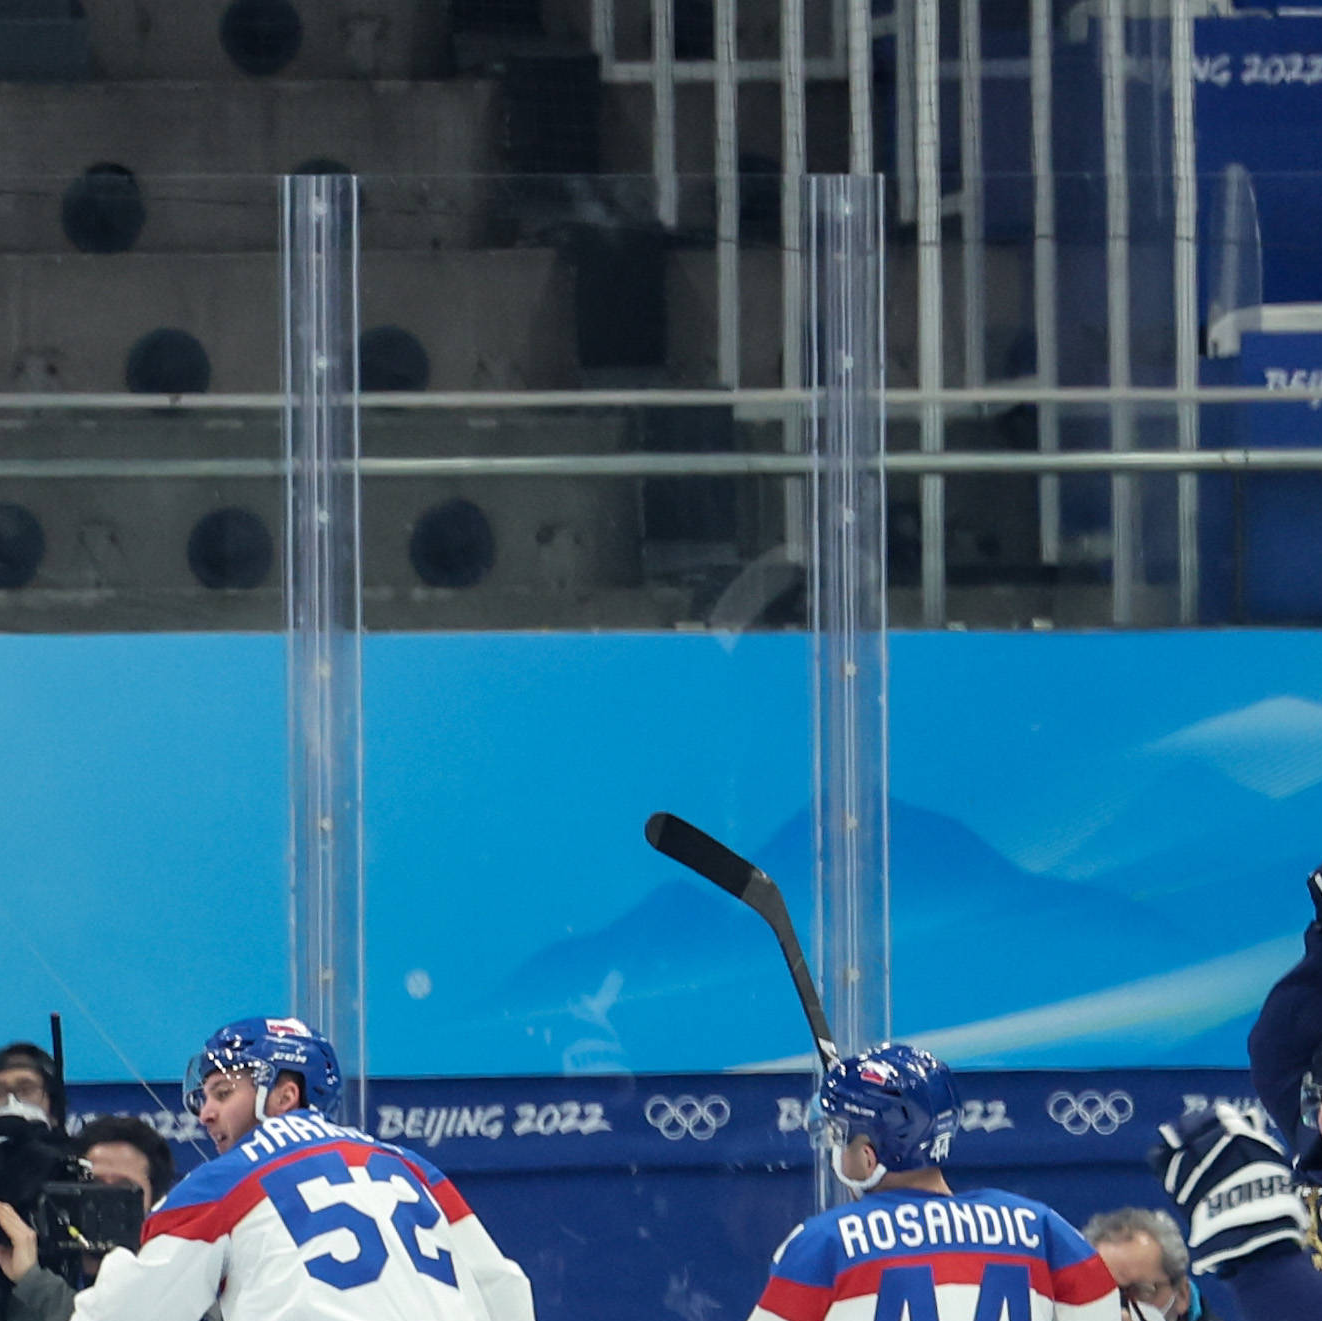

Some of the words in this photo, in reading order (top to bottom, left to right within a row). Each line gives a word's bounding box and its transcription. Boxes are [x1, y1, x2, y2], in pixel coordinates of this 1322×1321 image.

[377, 1103, 505, 1147] BEIJING
[512, 1101, 613, 1139] 2022
[259, 1149, 460, 1291] 52
[837, 1200, 1041, 1259] ROSANDIC
